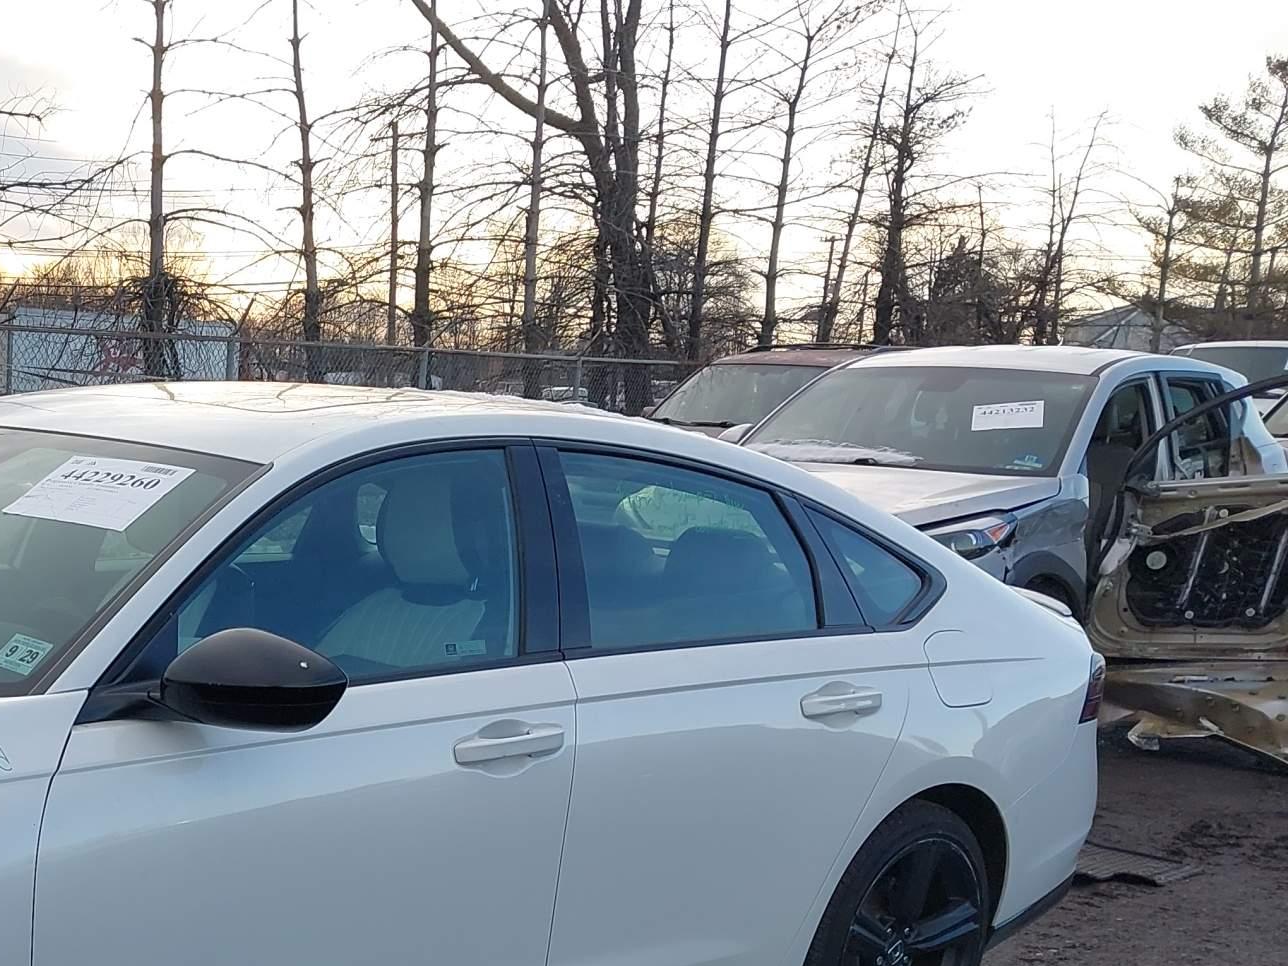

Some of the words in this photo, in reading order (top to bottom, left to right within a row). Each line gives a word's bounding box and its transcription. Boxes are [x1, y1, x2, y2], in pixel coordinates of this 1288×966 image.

[60, 469, 161, 490] 44229260
[5, 645, 19, 658] 9
[18, 649, 40, 664] 29
